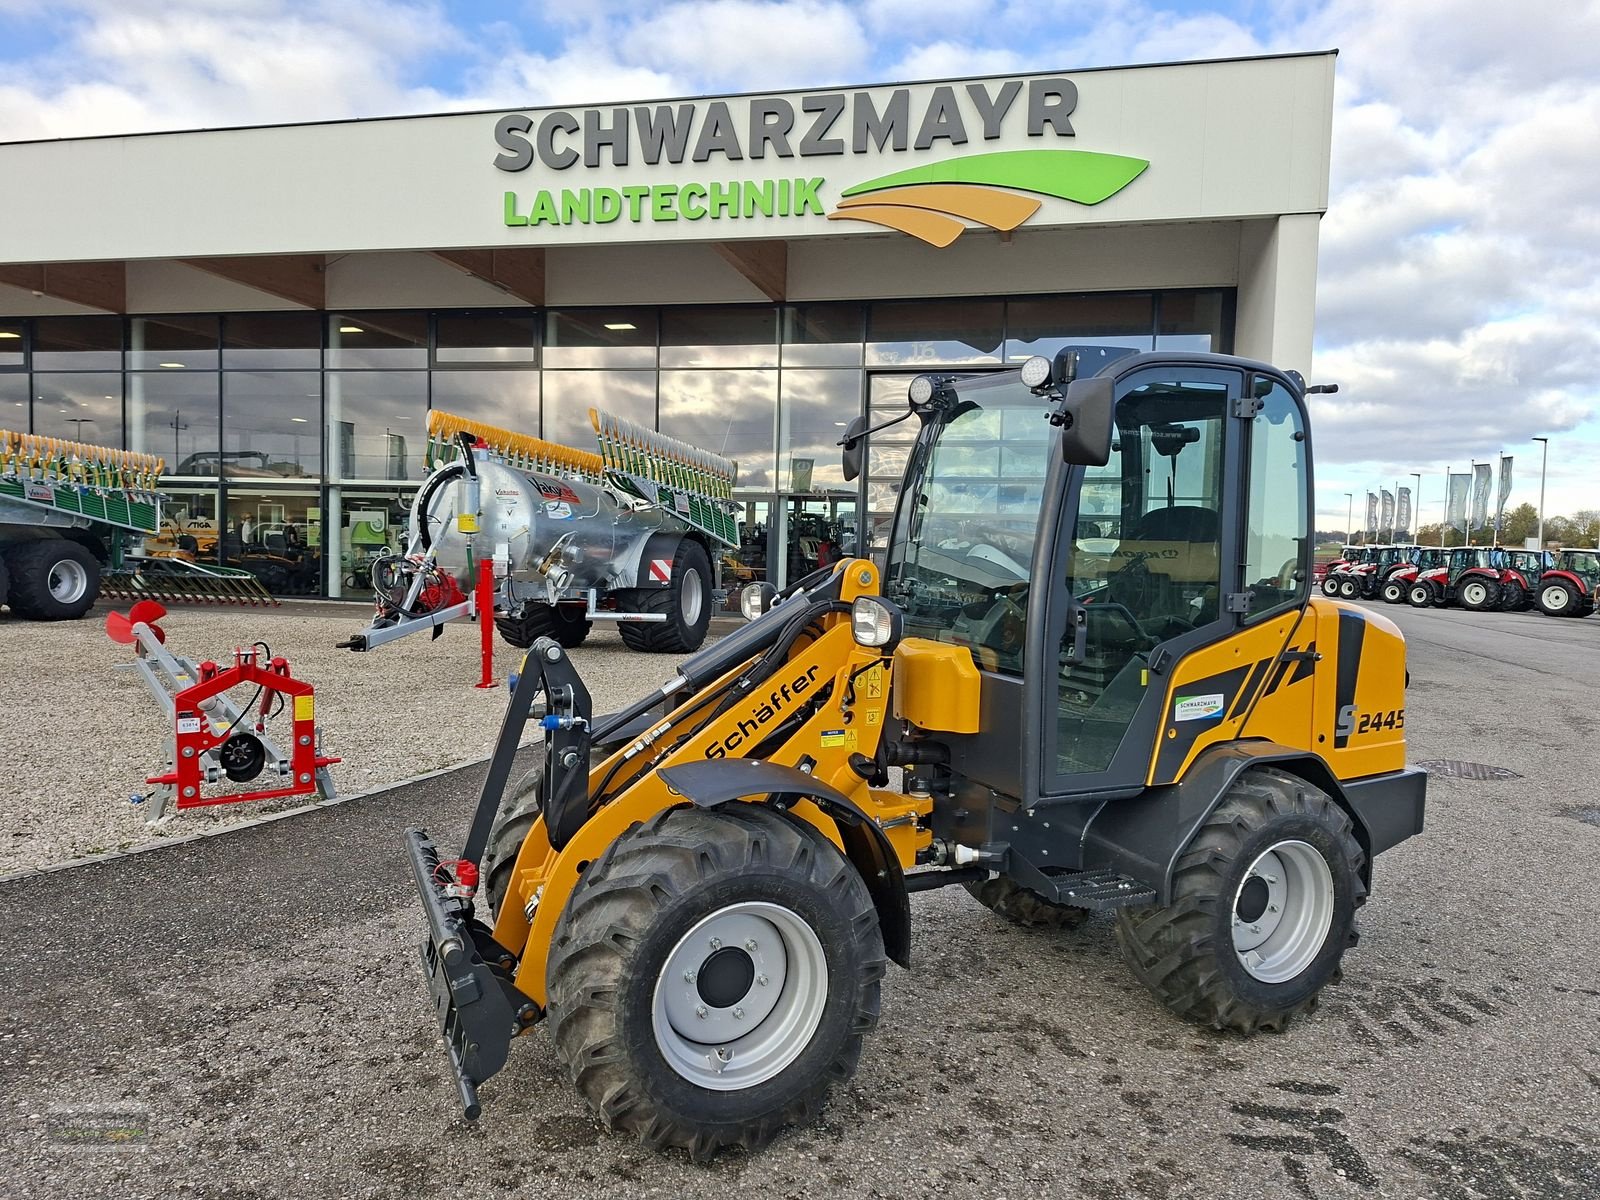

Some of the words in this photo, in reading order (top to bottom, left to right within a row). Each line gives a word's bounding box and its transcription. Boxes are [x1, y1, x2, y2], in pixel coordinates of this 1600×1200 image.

[493, 78, 1079, 173] SCHWARZMAYR
[504, 177, 826, 227] LANDTECHNIK
[187, 521, 212, 529] STIGA
[704, 664, 820, 760] Schäffer
[1180, 700, 1217, 709] SCHWARZMAYR
[1336, 704, 1358, 737] S
[1357, 709, 1406, 735] 2445
